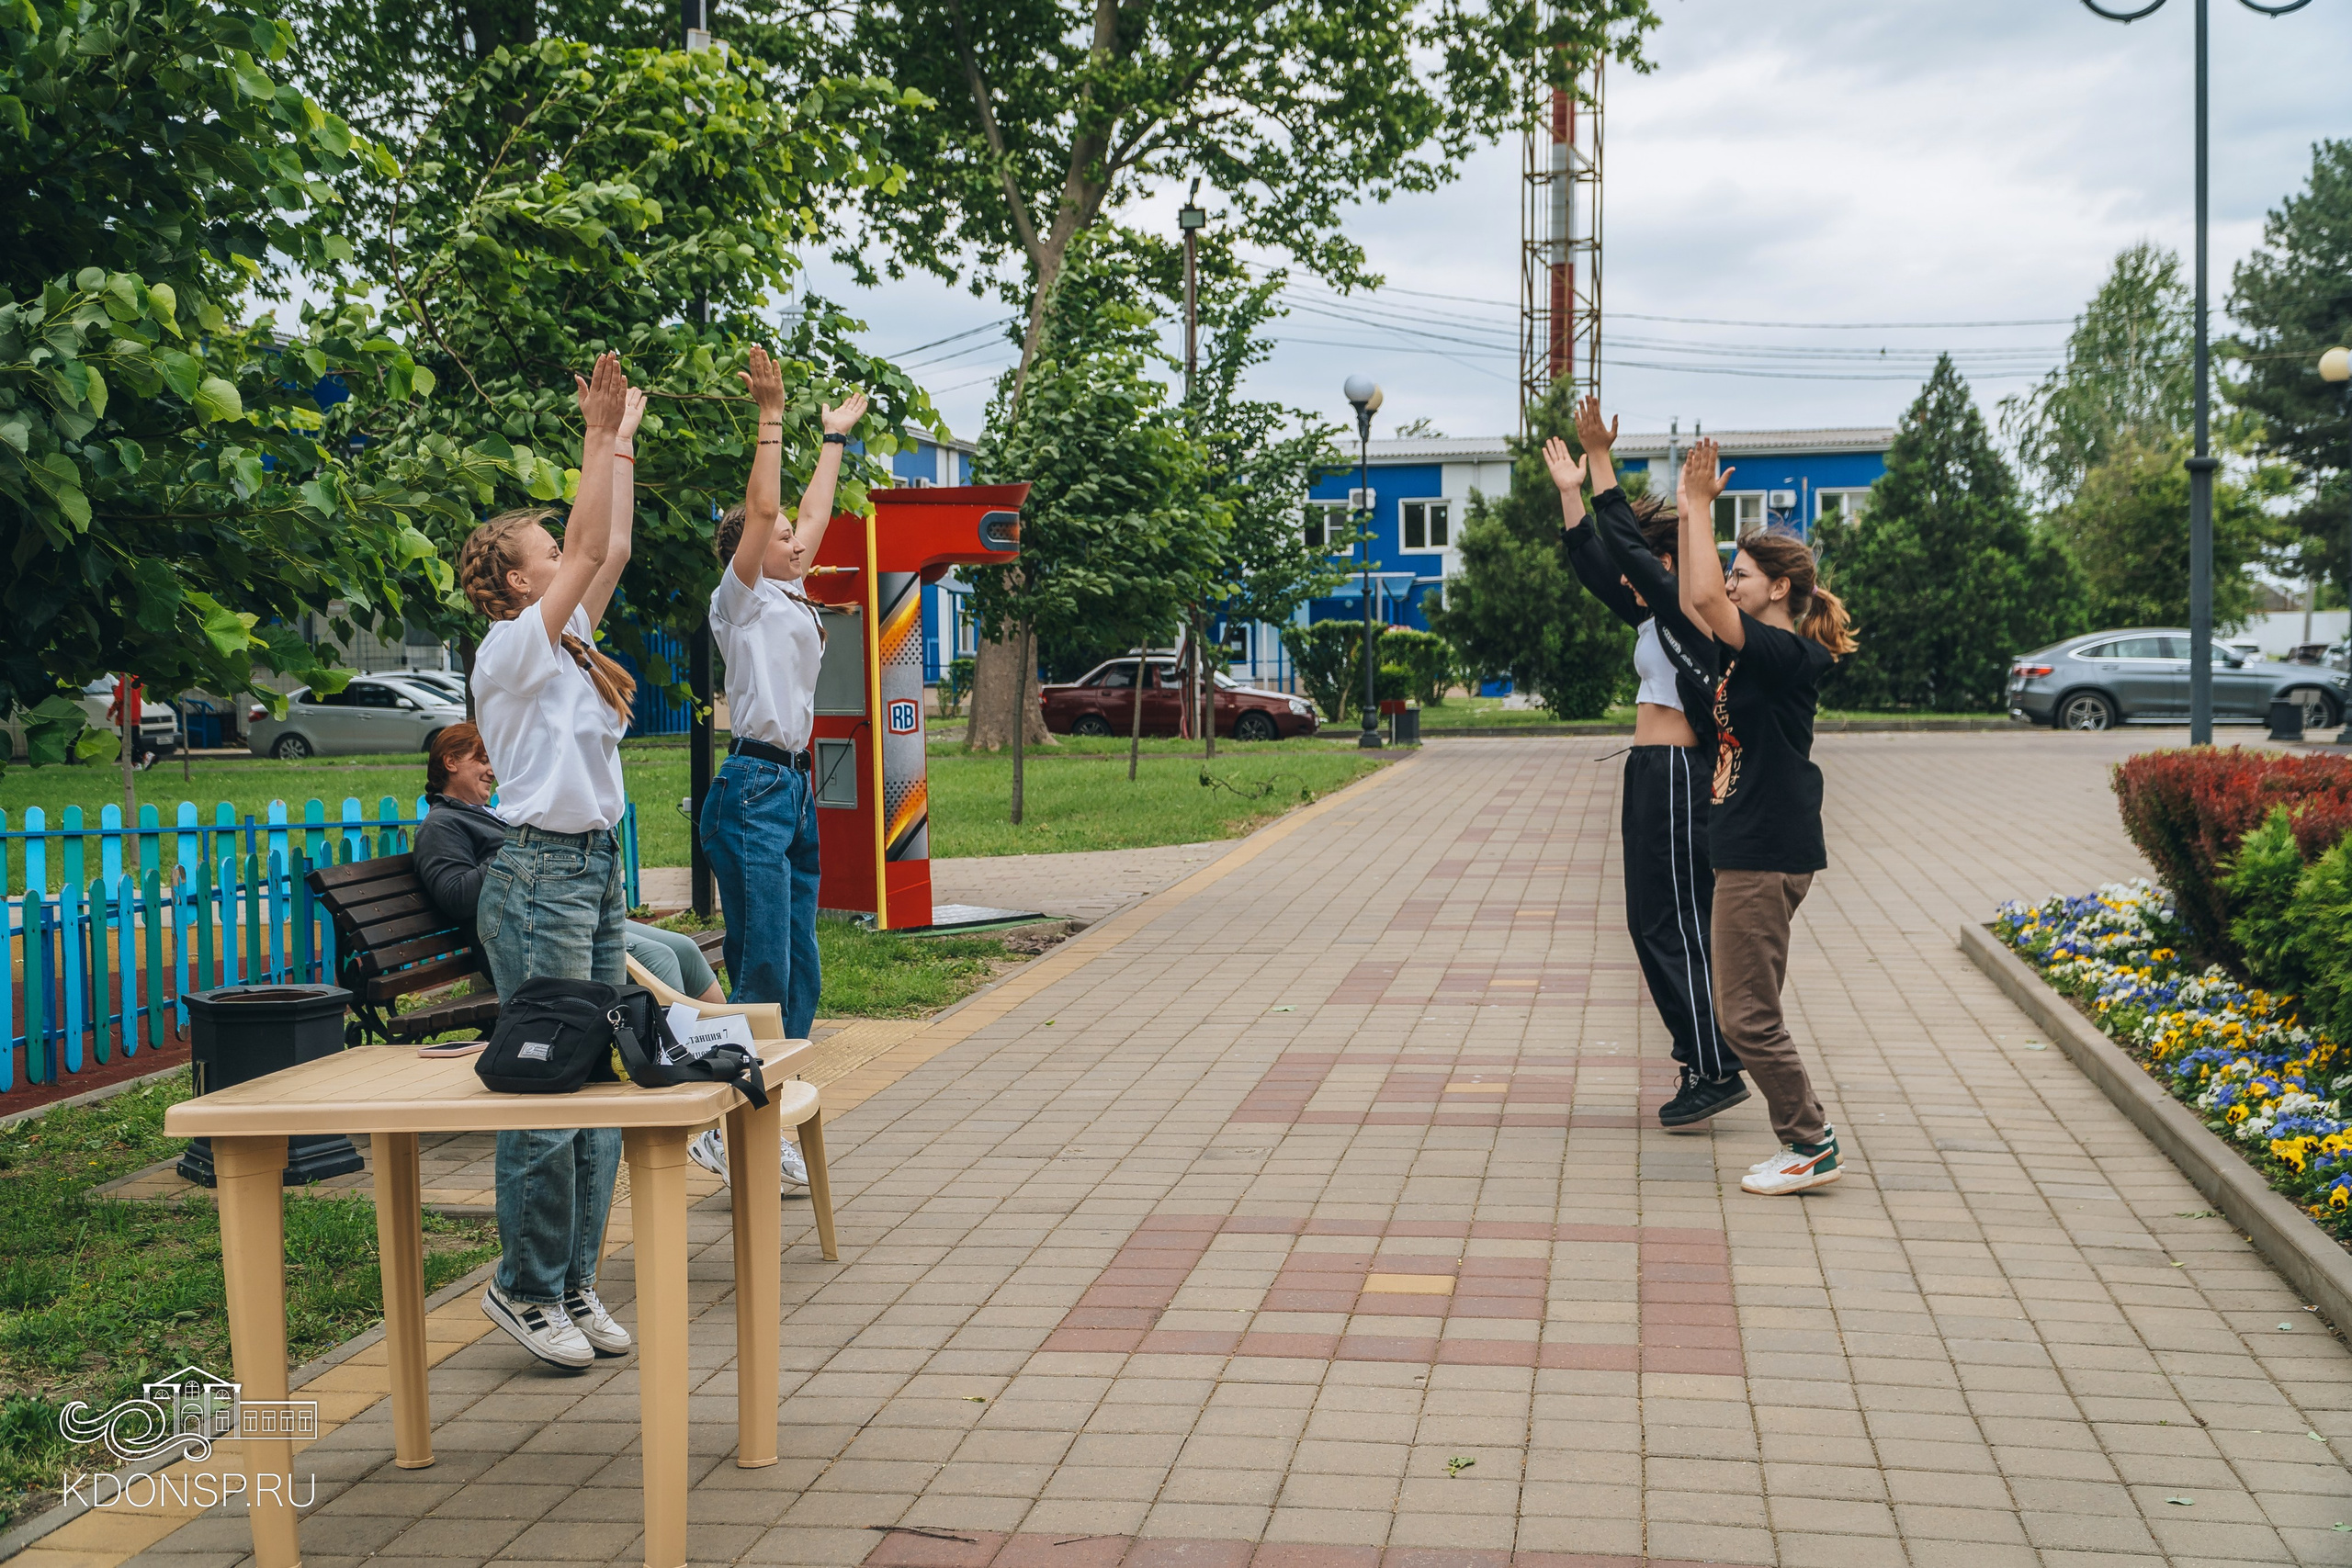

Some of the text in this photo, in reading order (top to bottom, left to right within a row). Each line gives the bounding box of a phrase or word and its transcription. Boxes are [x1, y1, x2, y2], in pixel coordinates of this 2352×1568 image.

[892, 705, 914, 729] RB
[685, 1028, 729, 1045] танция 7
